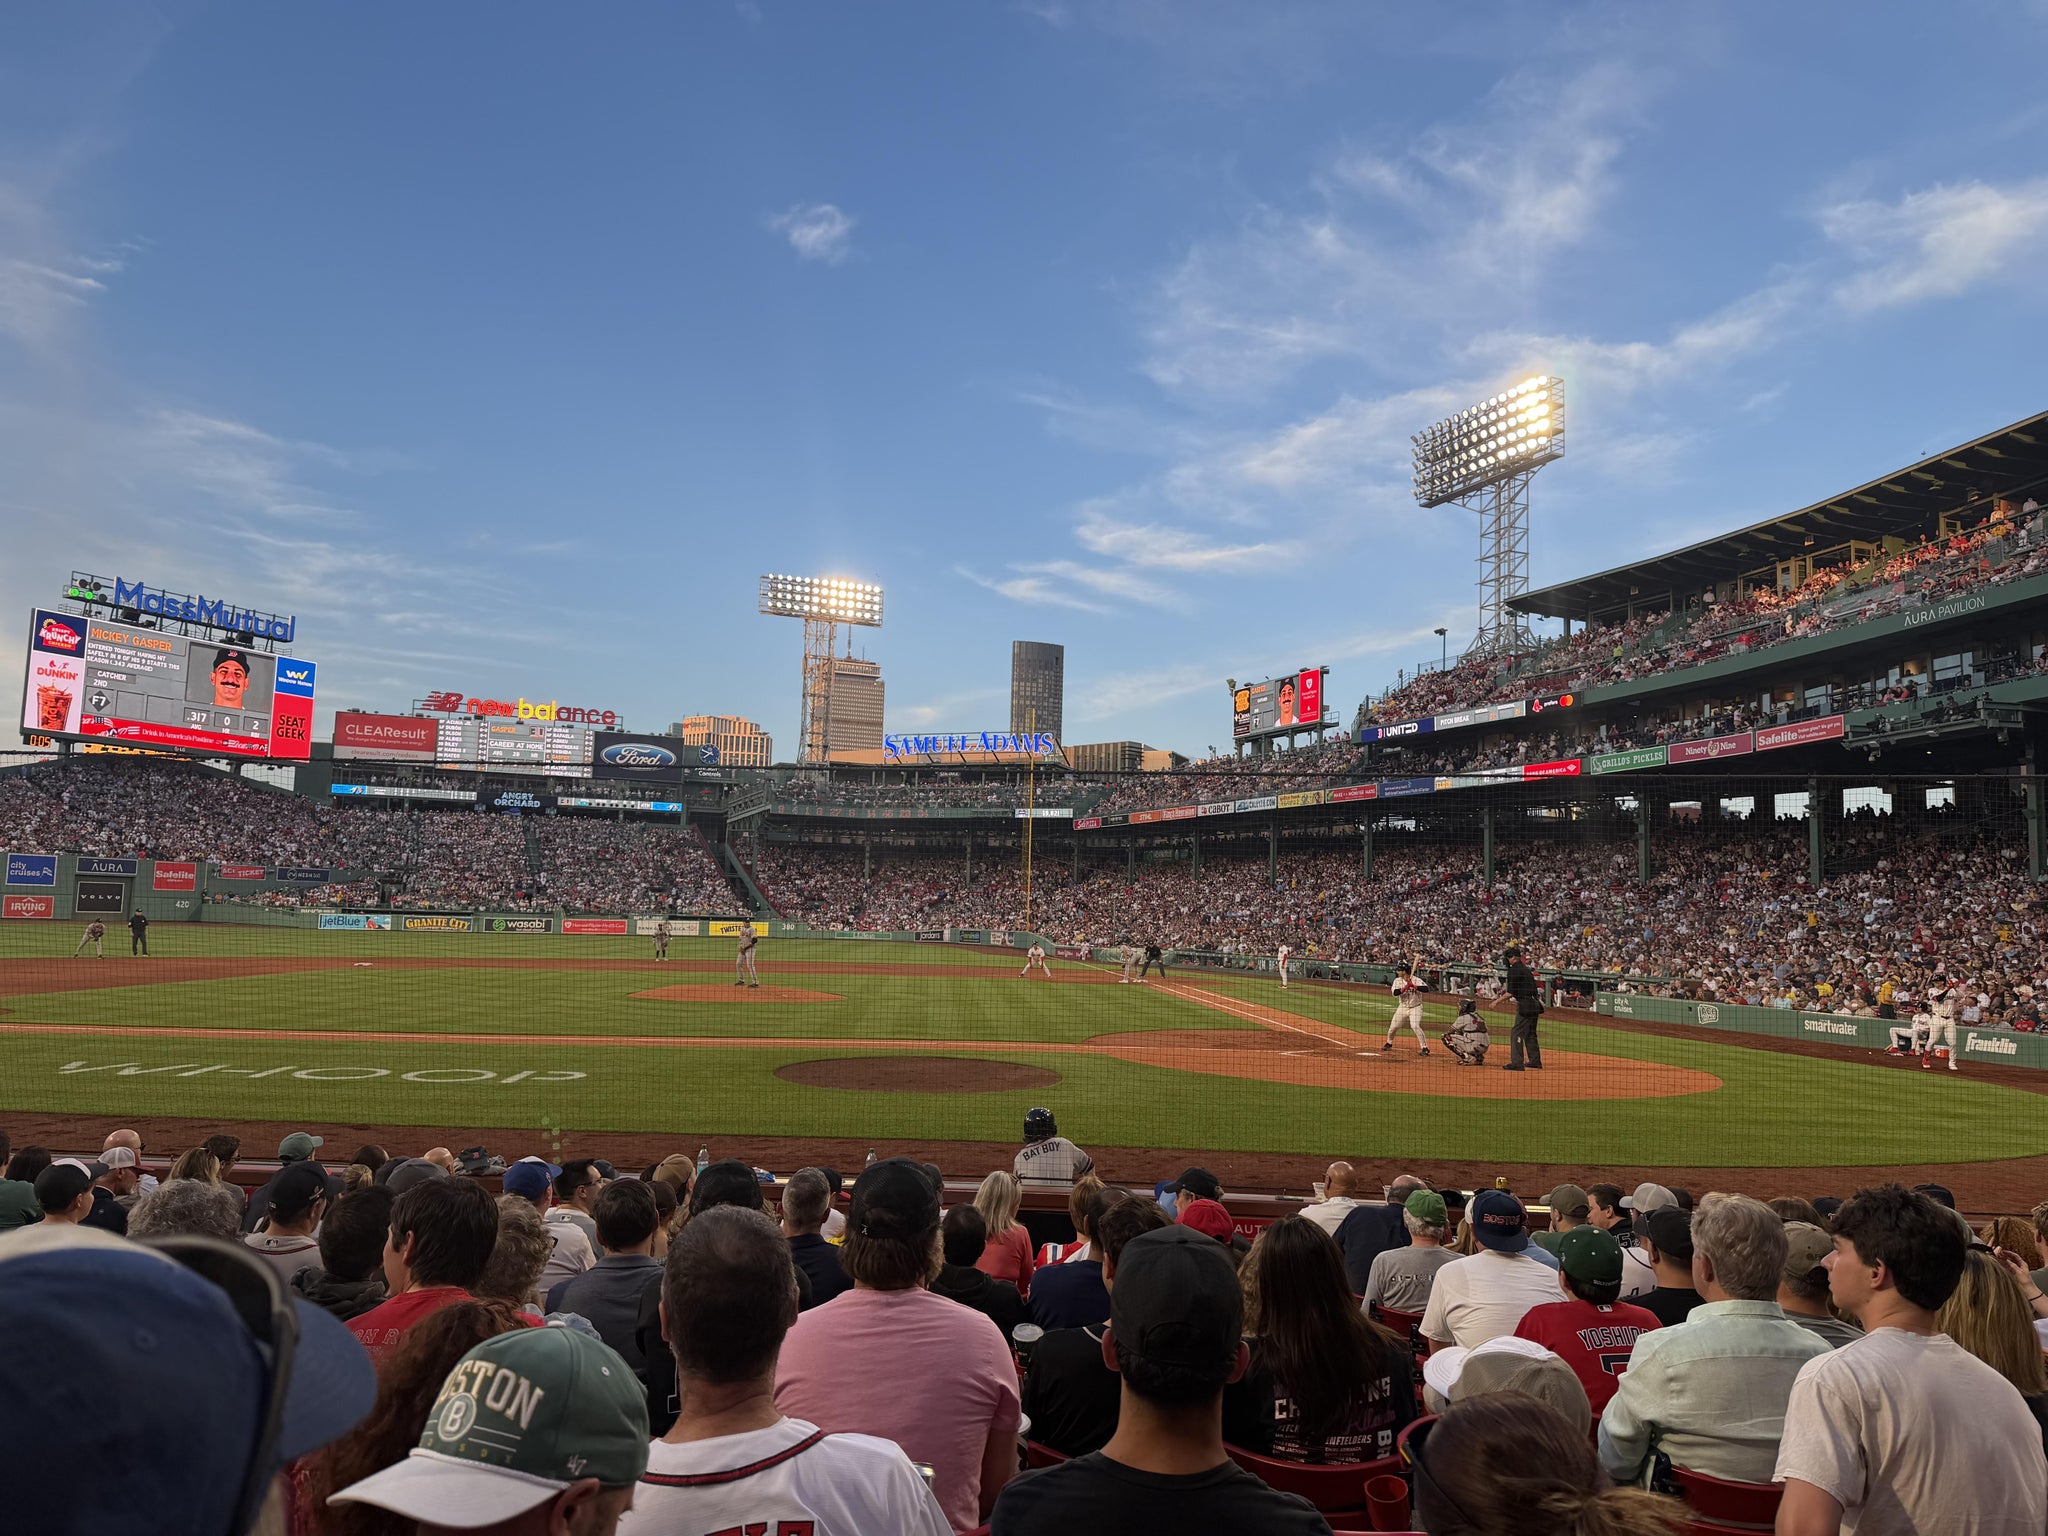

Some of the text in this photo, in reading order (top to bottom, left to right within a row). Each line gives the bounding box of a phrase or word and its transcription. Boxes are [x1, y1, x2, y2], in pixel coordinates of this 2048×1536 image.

[114, 575, 296, 642] MassMutual
[1938, 596, 1985, 618] PAVILION
[39, 628, 81, 645] KRUNCHY
[91, 628, 172, 652] MICKEY GASPER
[88, 642, 113, 652] ENTERED
[114, 646, 136, 656] TONIGHT
[138, 650, 156, 660] HAVING
[87, 656, 109, 665] SEASON
[88, 649, 108, 659] SAFELY
[147, 660, 167, 669] STARTS
[36, 667, 78, 680] DUNKIN'
[97, 670, 126, 681] CATCHER
[92, 696, 106, 706] F7
[467, 698, 616, 726] new balance
[187, 712, 259, 730] .317 0 2
[279, 715, 306, 728] SEAT
[1440, 714, 1470, 726] PITCH BREAK
[142, 729, 158, 737] Drink
[166, 732, 190, 741] America's
[191, 735, 214, 744] Pastime
[276, 726, 305, 740] GEEK
[346, 724, 426, 740] CLEAResult
[1386, 722, 1418, 738] UNITED
[884, 730, 1054, 758] SAMUEL ADAMS
[1758, 731, 1798, 746] Safelite
[616, 746, 660, 765] Ford
[1686, 741, 1736, 756] Ninety Nine
[1602, 752, 1663, 769] GRILLO'S PICKLES
[494, 799, 540, 808] ORCHARD
[501, 792, 534, 800] ANGRY
[9, 868, 40, 877] cruises
[10, 862, 26, 870] city
[238, 869, 264, 878] TICKET
[155, 870, 194, 880] Safelite
[11, 902, 46, 912] IRVING
[323, 916, 360, 928] jetBlue
[406, 918, 447, 929] GRANITE
[450, 918, 470, 930] CITY
[507, 919, 545, 929] wasabi
[720, 926, 741, 934] TWISTE
[1804, 1019, 1858, 1036] smartwater
[1965, 1032, 2018, 1055] franklin
[58, 1061, 587, 1084] WHOOP
[1022, 1141, 1060, 1161] BAT BOY
[1234, 1225, 1262, 1234] AUT
[1577, 1326, 1648, 1350] YOSHID
[441, 1359, 544, 1431] OSTON
[1326, 1434, 1372, 1446] INFIELDERS
